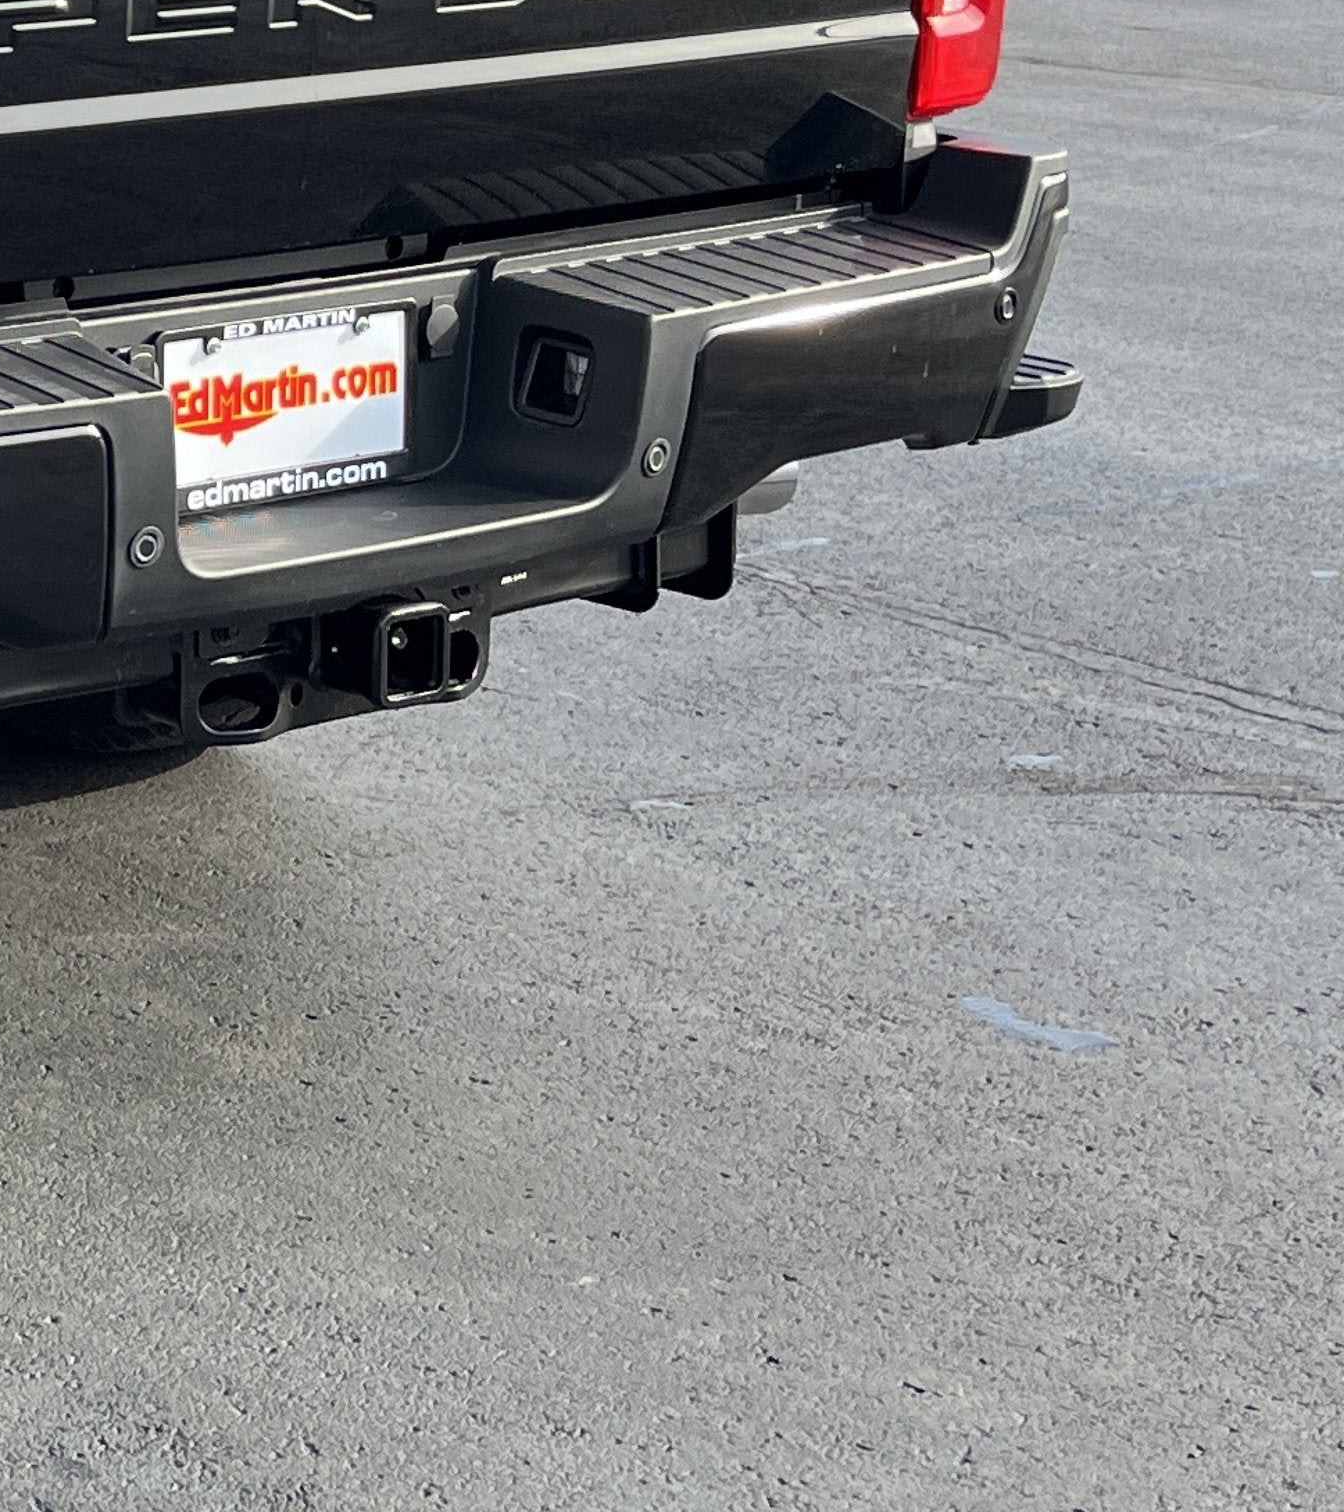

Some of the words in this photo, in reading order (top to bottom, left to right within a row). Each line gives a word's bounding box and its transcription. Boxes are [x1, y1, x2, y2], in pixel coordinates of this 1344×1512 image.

[223, 322, 257, 340] ED
[262, 308, 356, 335] MARTIN
[169, 362, 398, 426] EdMartin.com
[186, 459, 387, 510] edmartin.com
